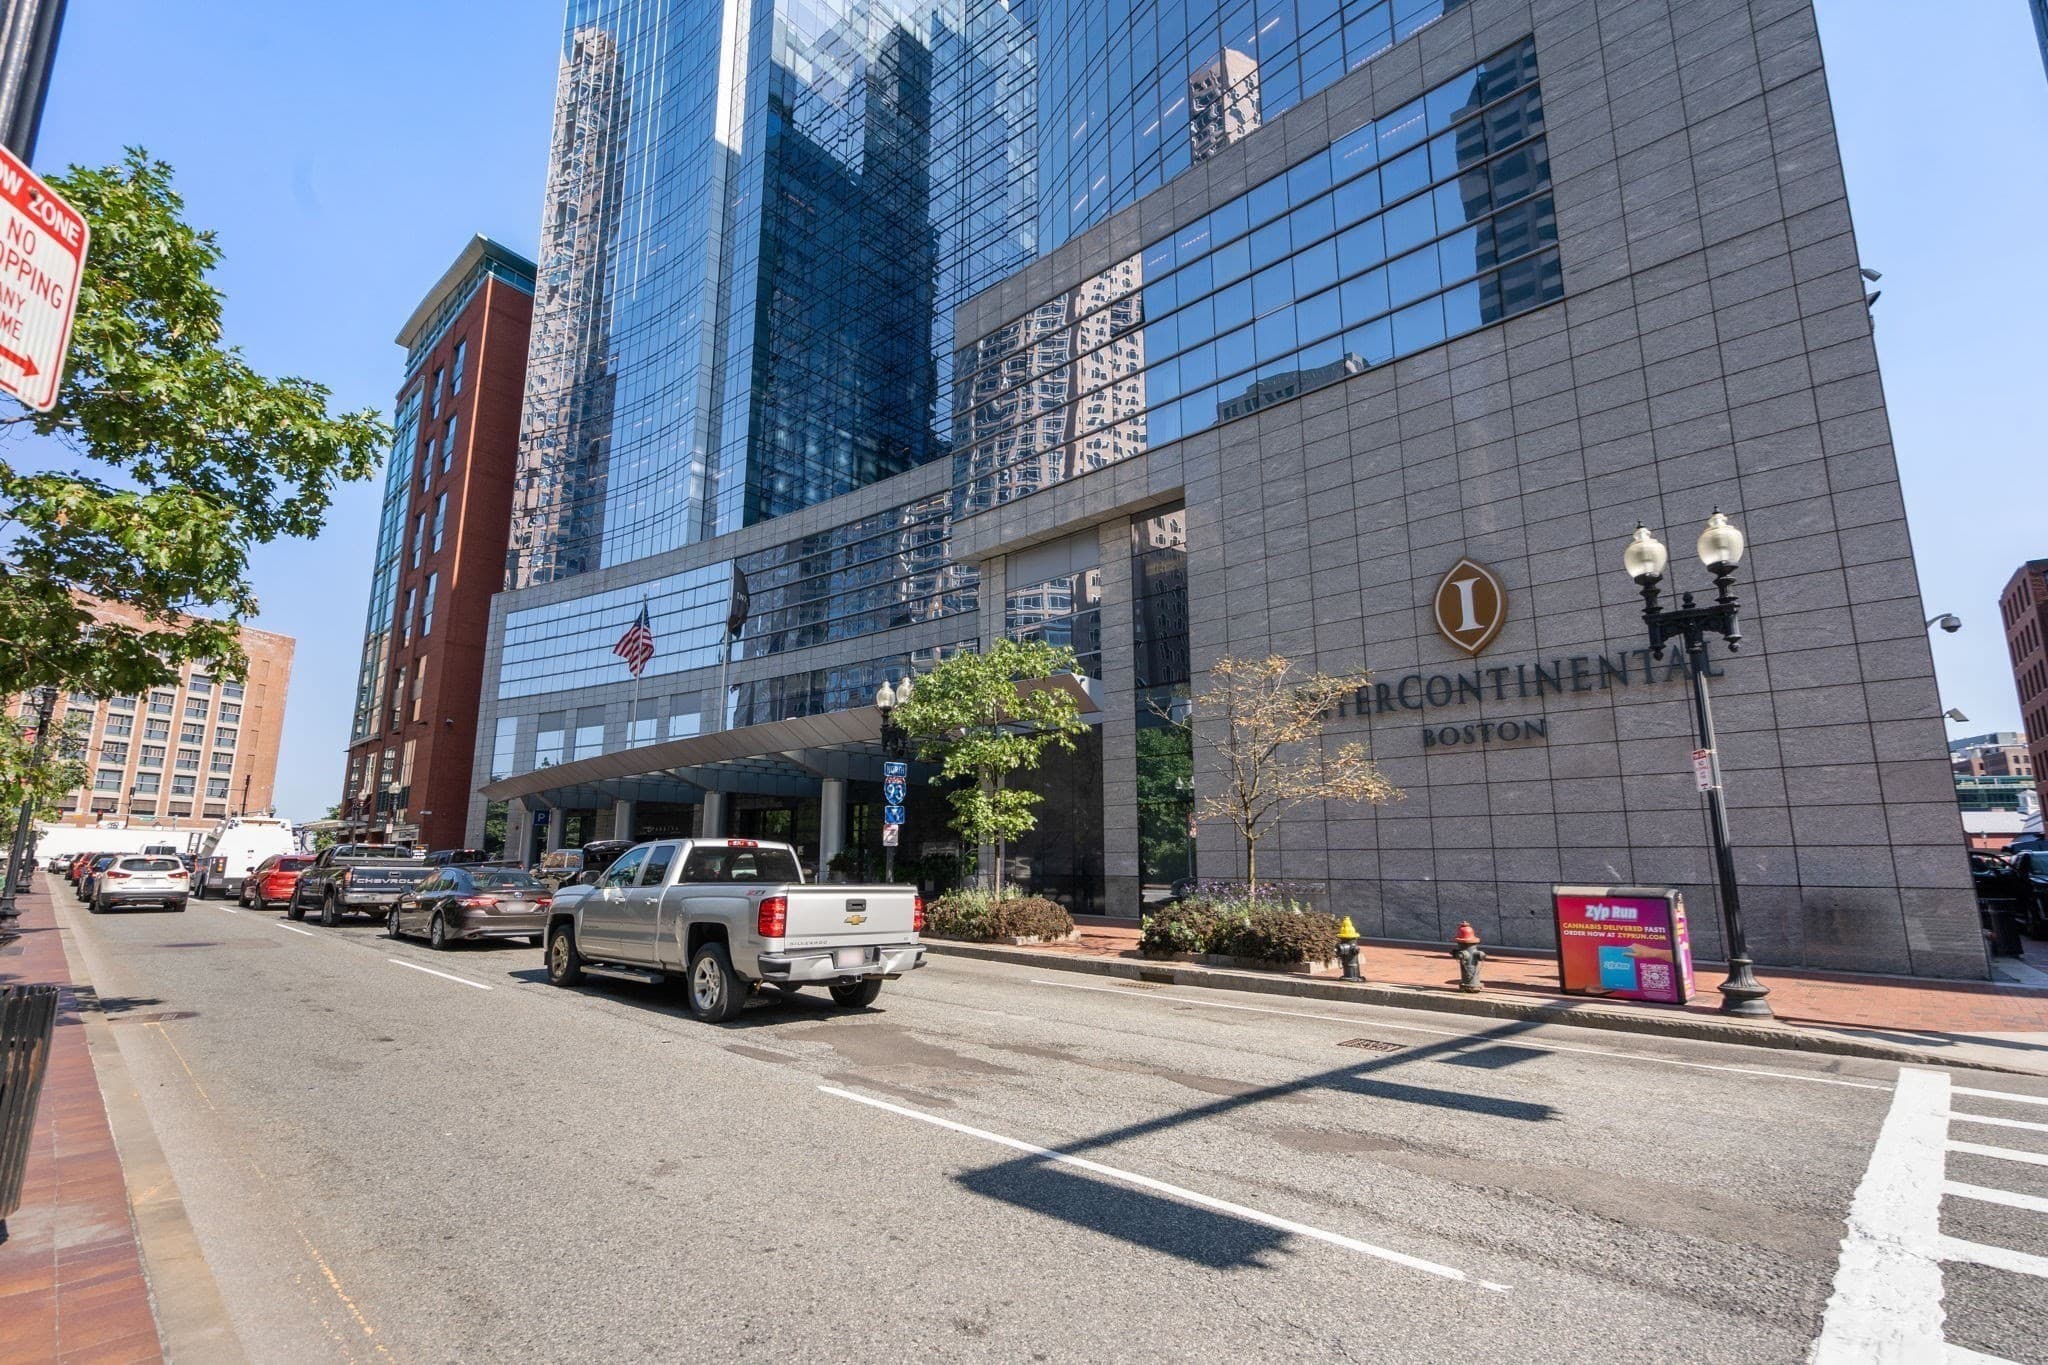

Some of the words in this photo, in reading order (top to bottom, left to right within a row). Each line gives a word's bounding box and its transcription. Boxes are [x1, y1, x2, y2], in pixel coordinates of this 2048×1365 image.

[28, 186, 81, 247] ZONE
[8, 216, 36, 255] NO
[0, 242, 63, 309] PPING
[0, 283, 26, 313] NY
[0, 311, 23, 340] ME
[1423, 719, 1546, 747] BOSTON
[886, 766, 905, 775] NORTH
[886, 784, 904, 800] 93
[537, 812, 546, 823] P
[1611, 905, 1638, 919] Run
[1562, 922, 1602, 930] CANNABIS
[1602, 924, 1643, 932] DELIVERED
[1617, 932, 1666, 940] ZYPRUN.COM
